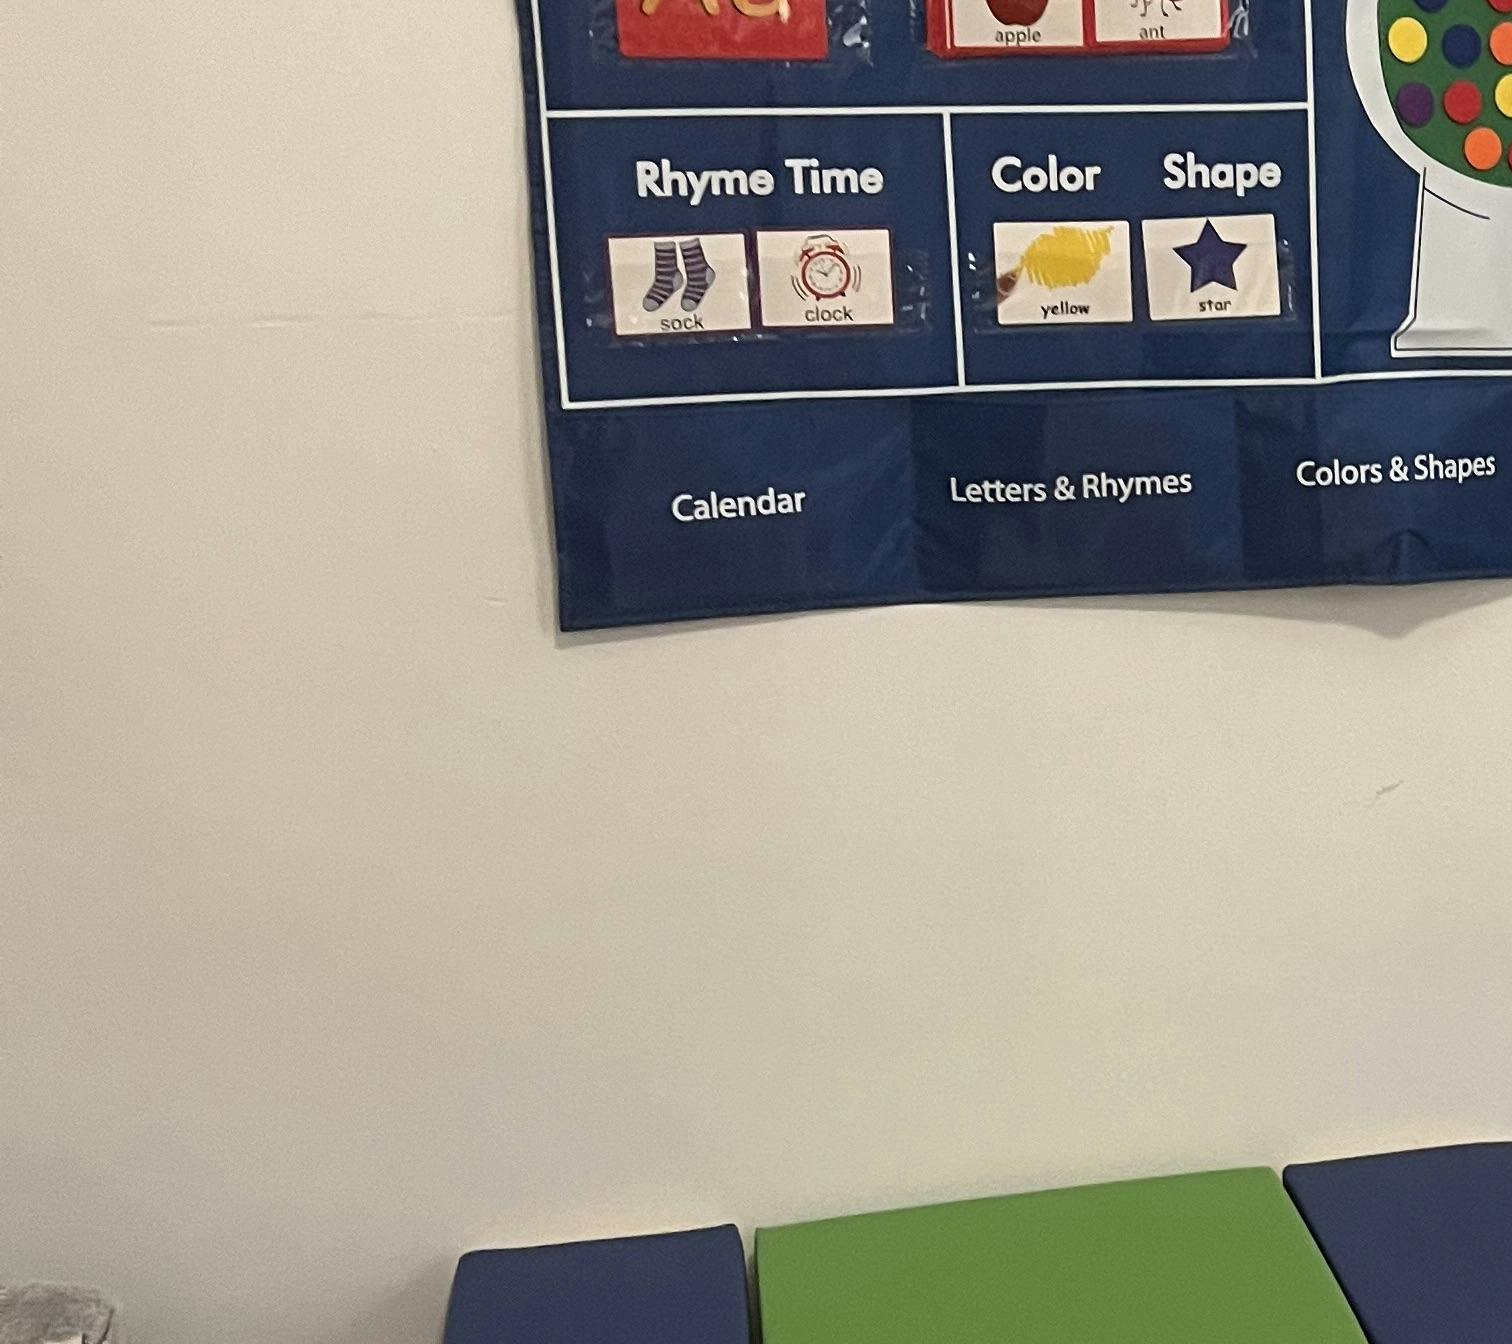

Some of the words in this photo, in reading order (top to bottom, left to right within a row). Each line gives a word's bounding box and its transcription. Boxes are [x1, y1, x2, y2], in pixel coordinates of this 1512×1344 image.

[995, 27, 1042, 45] apple
[1138, 23, 1166, 40] ant
[635, 158, 775, 206] Rhyme
[784, 158, 884, 195] Time
[991, 155, 1100, 193] Color
[1163, 152, 1282, 196] Shape
[805, 304, 854, 323] clock
[1040, 300, 1090, 319] yellow
[1198, 297, 1231, 313] star
[660, 312, 705, 332] sock
[1296, 458, 1383, 487] Colors
[1388, 456, 1410, 482] &
[1413, 451, 1497, 485] Shapes
[950, 476, 1048, 504] Letters
[1053, 476, 1076, 500] &
[1082, 471, 1192, 506] Rhymes
[671, 487, 806, 523] Calendar
